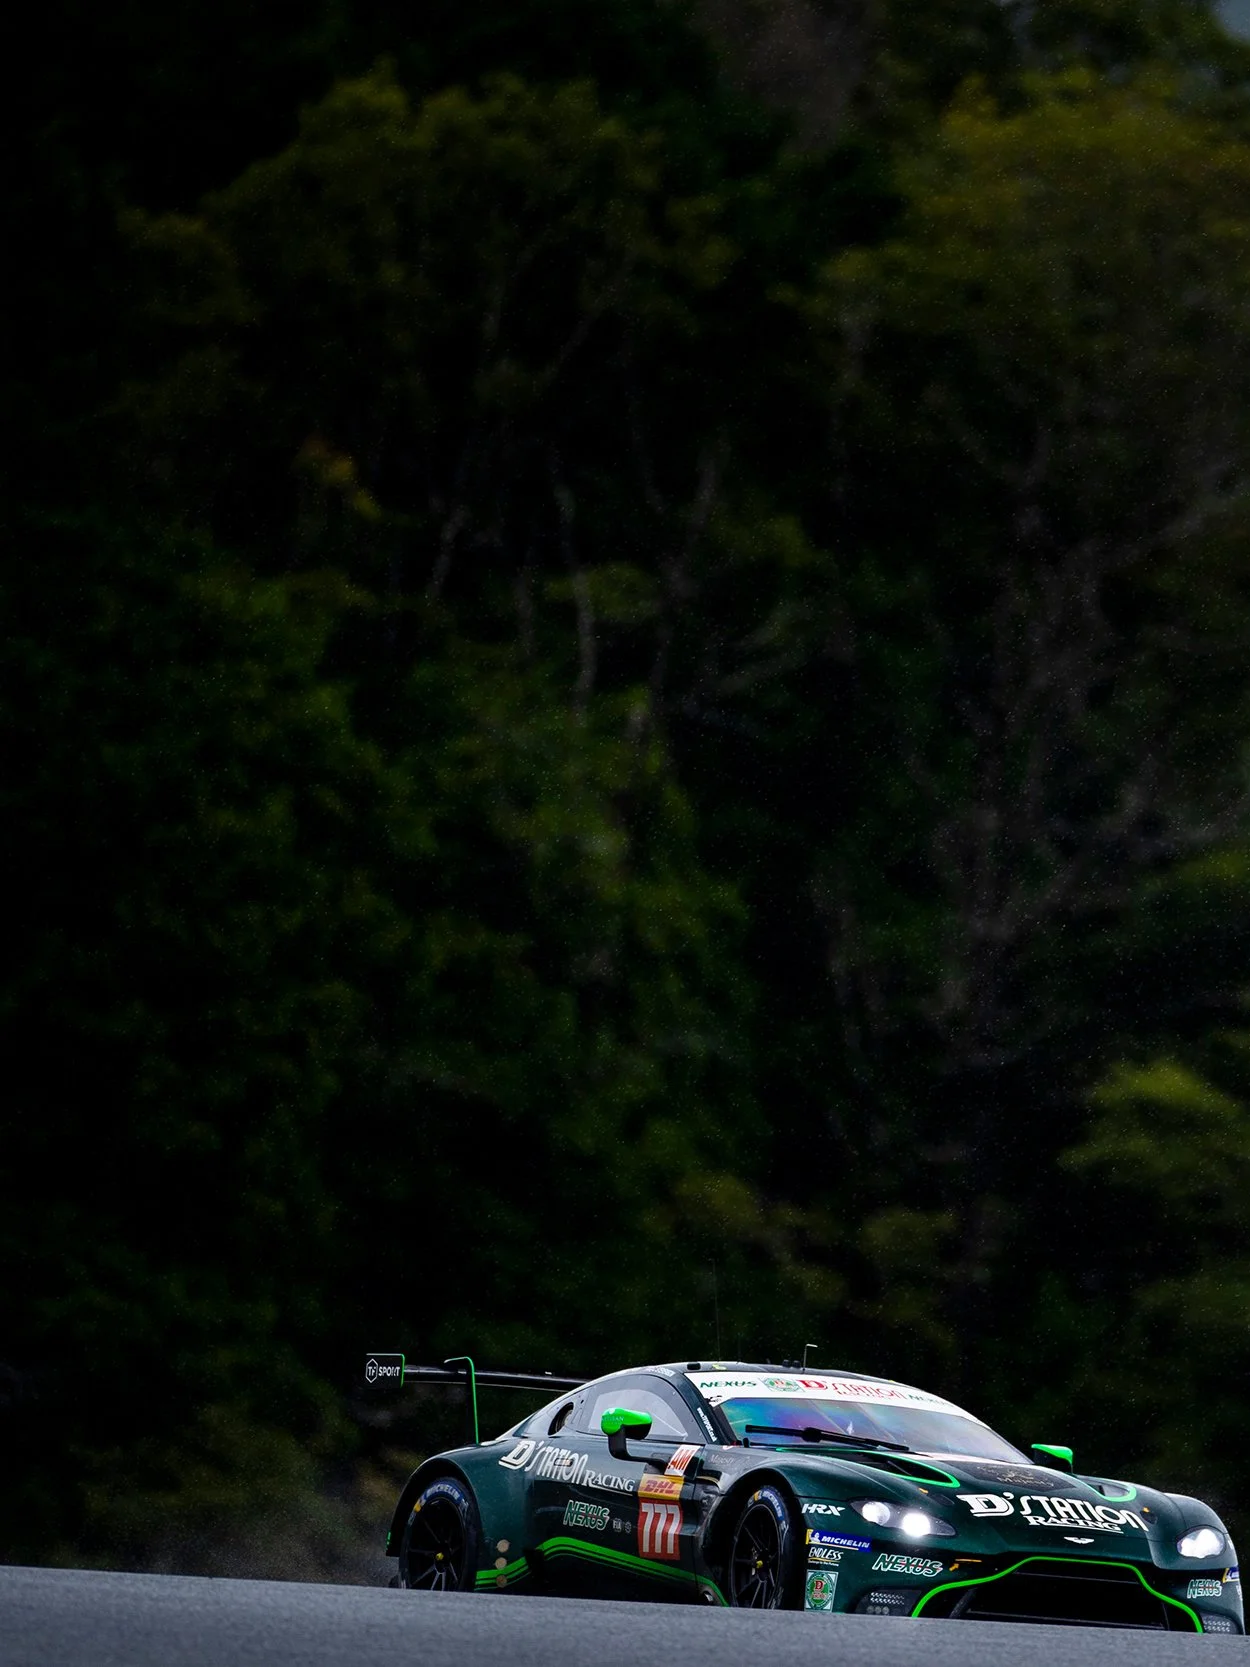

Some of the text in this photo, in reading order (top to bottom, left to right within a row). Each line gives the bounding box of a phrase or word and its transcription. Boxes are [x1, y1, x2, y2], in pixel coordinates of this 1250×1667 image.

[378, 1366, 401, 1377] SPORT
[667, 1449, 698, 1471] AM
[581, 1469, 635, 1492] RACING
[644, 1480, 678, 1494] DHL
[563, 1500, 610, 1531] NEXUS
[801, 1503, 846, 1517] HRX
[641, 1502, 680, 1554] 777
[1023, 1515, 1122, 1531] RACING
[821, 1536, 870, 1549] MICHELIN
[808, 1546, 844, 1561] ENDLESS
[871, 1552, 944, 1577] NEXUS
[1187, 1578, 1223, 1599] NEXUS
